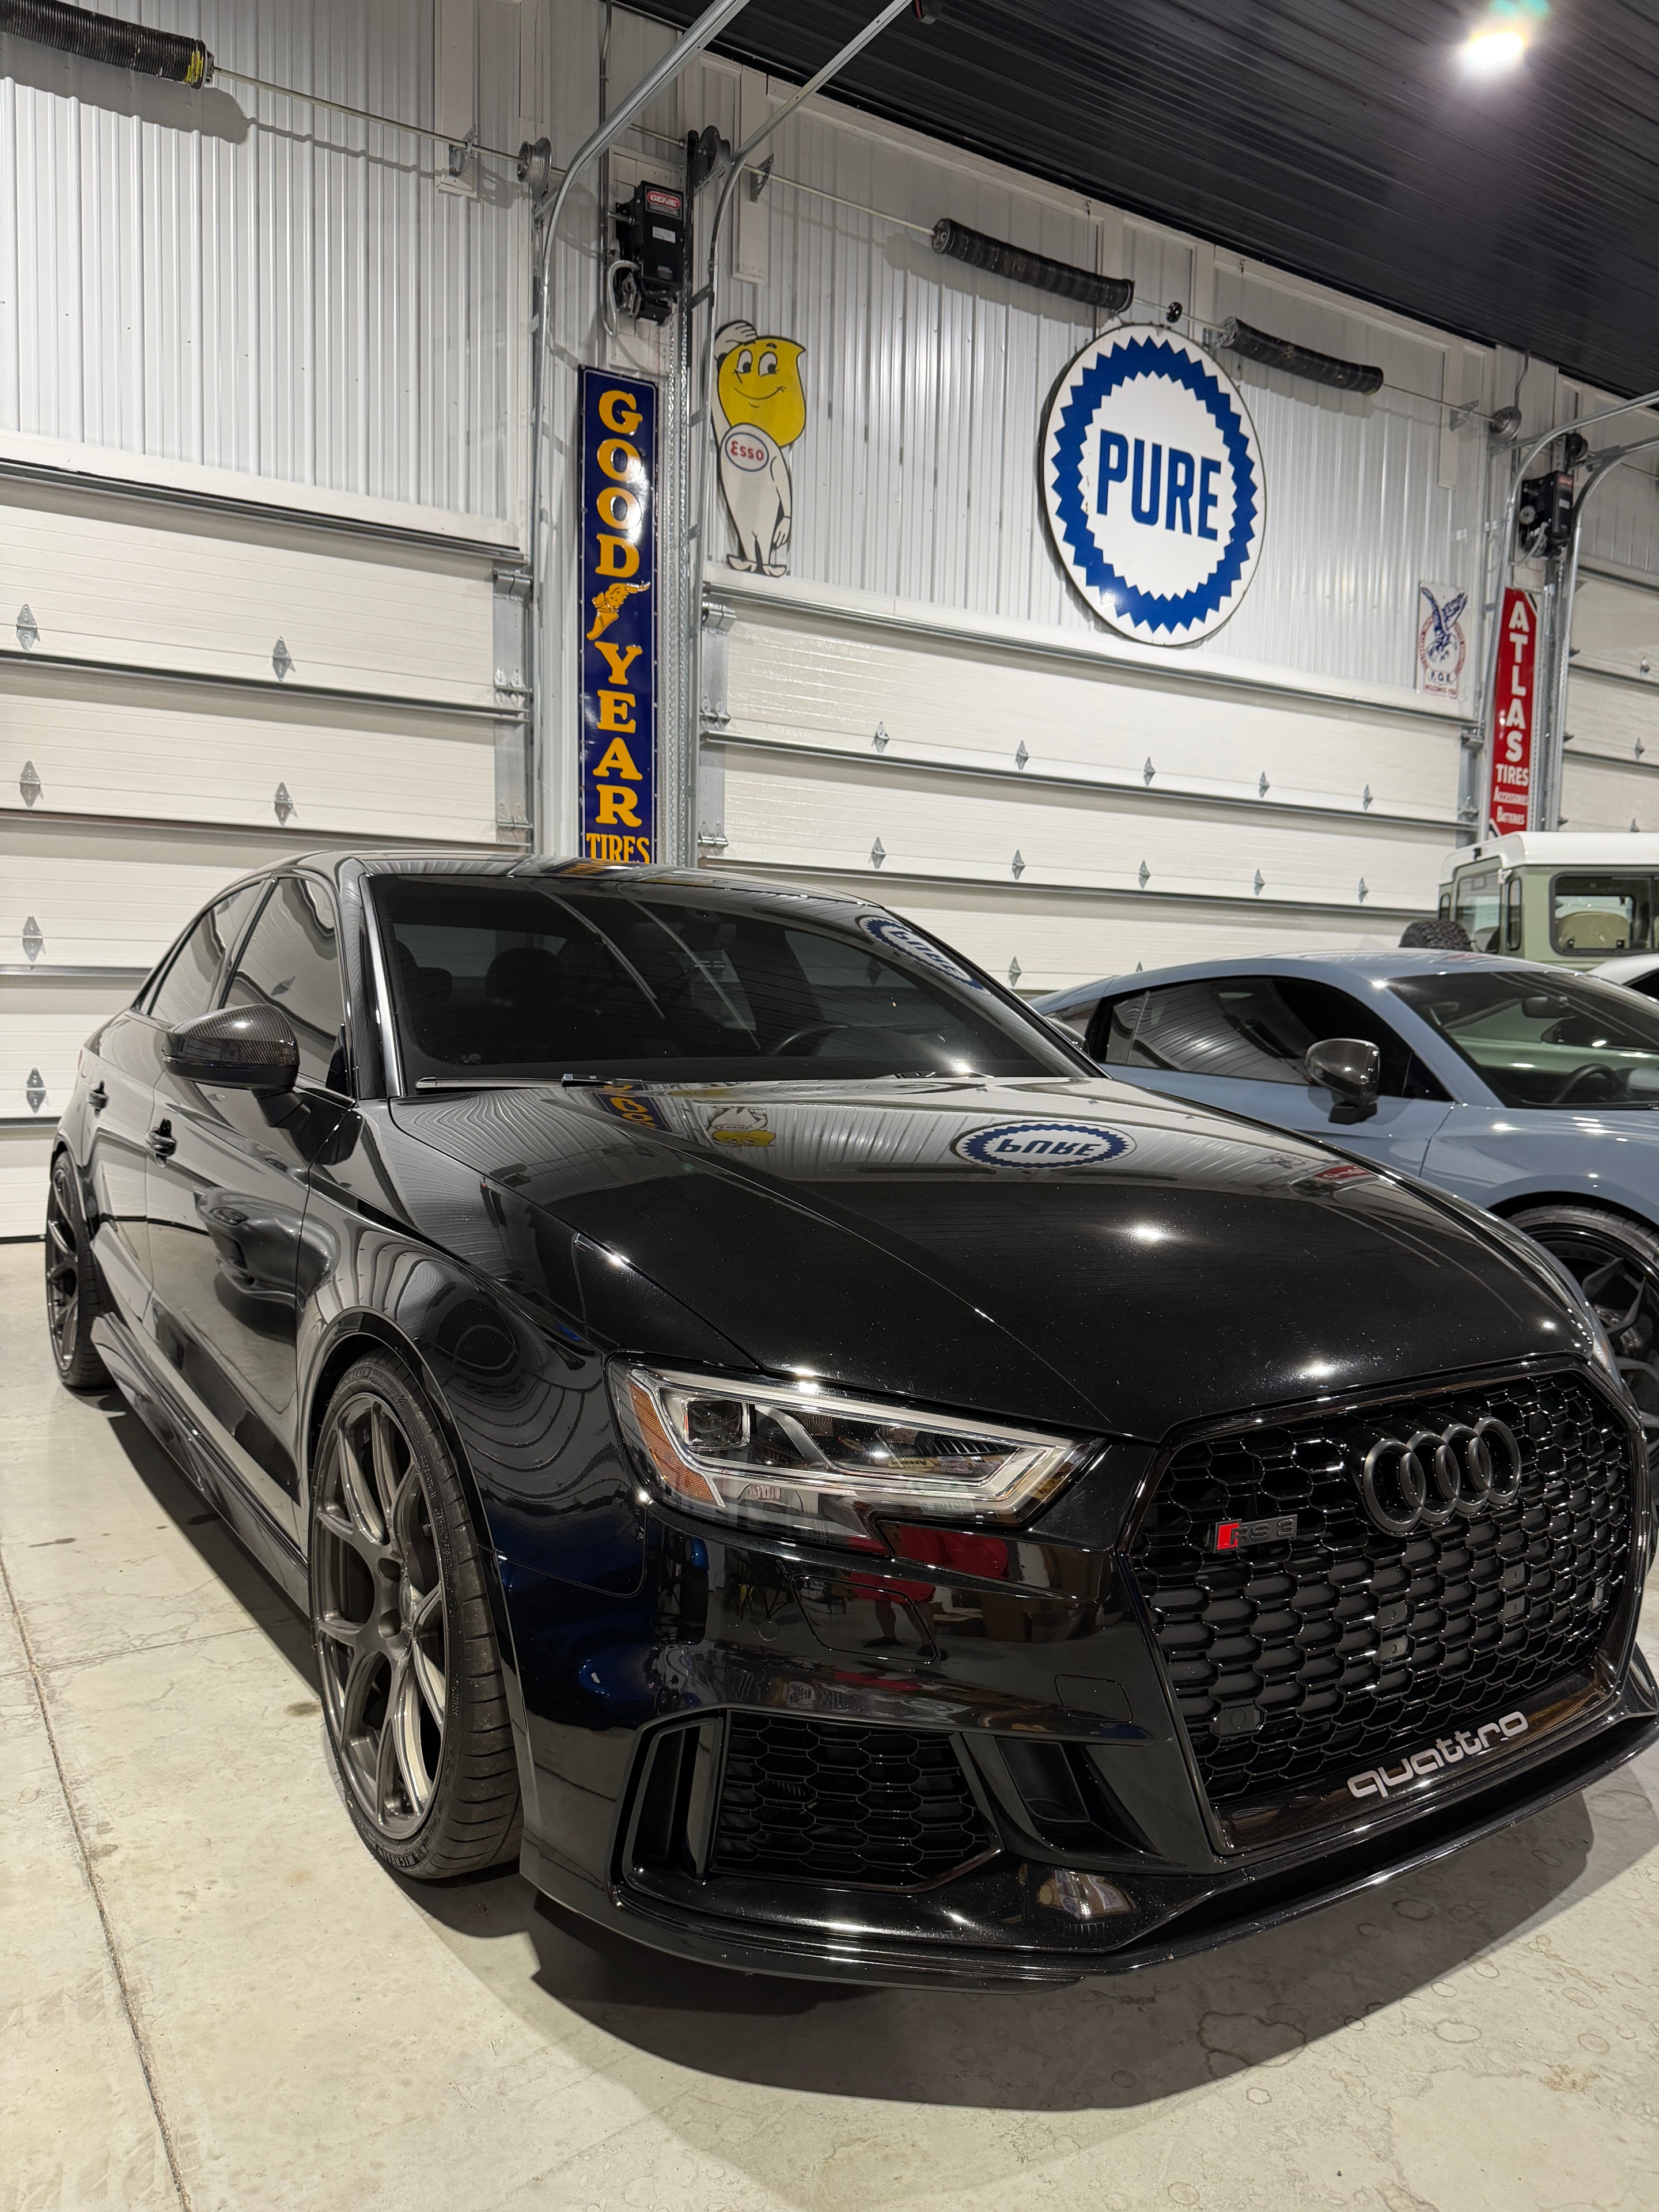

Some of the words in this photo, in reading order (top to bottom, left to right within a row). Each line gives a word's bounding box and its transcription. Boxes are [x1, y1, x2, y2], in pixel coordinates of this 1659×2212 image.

[650, 194, 677, 207] GENIE
[595, 390, 643, 578] GOOD
[1096, 428, 1221, 542] PURE
[1505, 600, 1530, 763] ATLAS
[593, 641, 643, 827] YEAR
[1495, 763, 1529, 786] TIRES
[585, 833, 650, 864] TIRES
[1229, 1522, 1271, 1546] RS
[1277, 1518, 1295, 1536] 3
[1347, 1711, 1529, 1798] quattro
